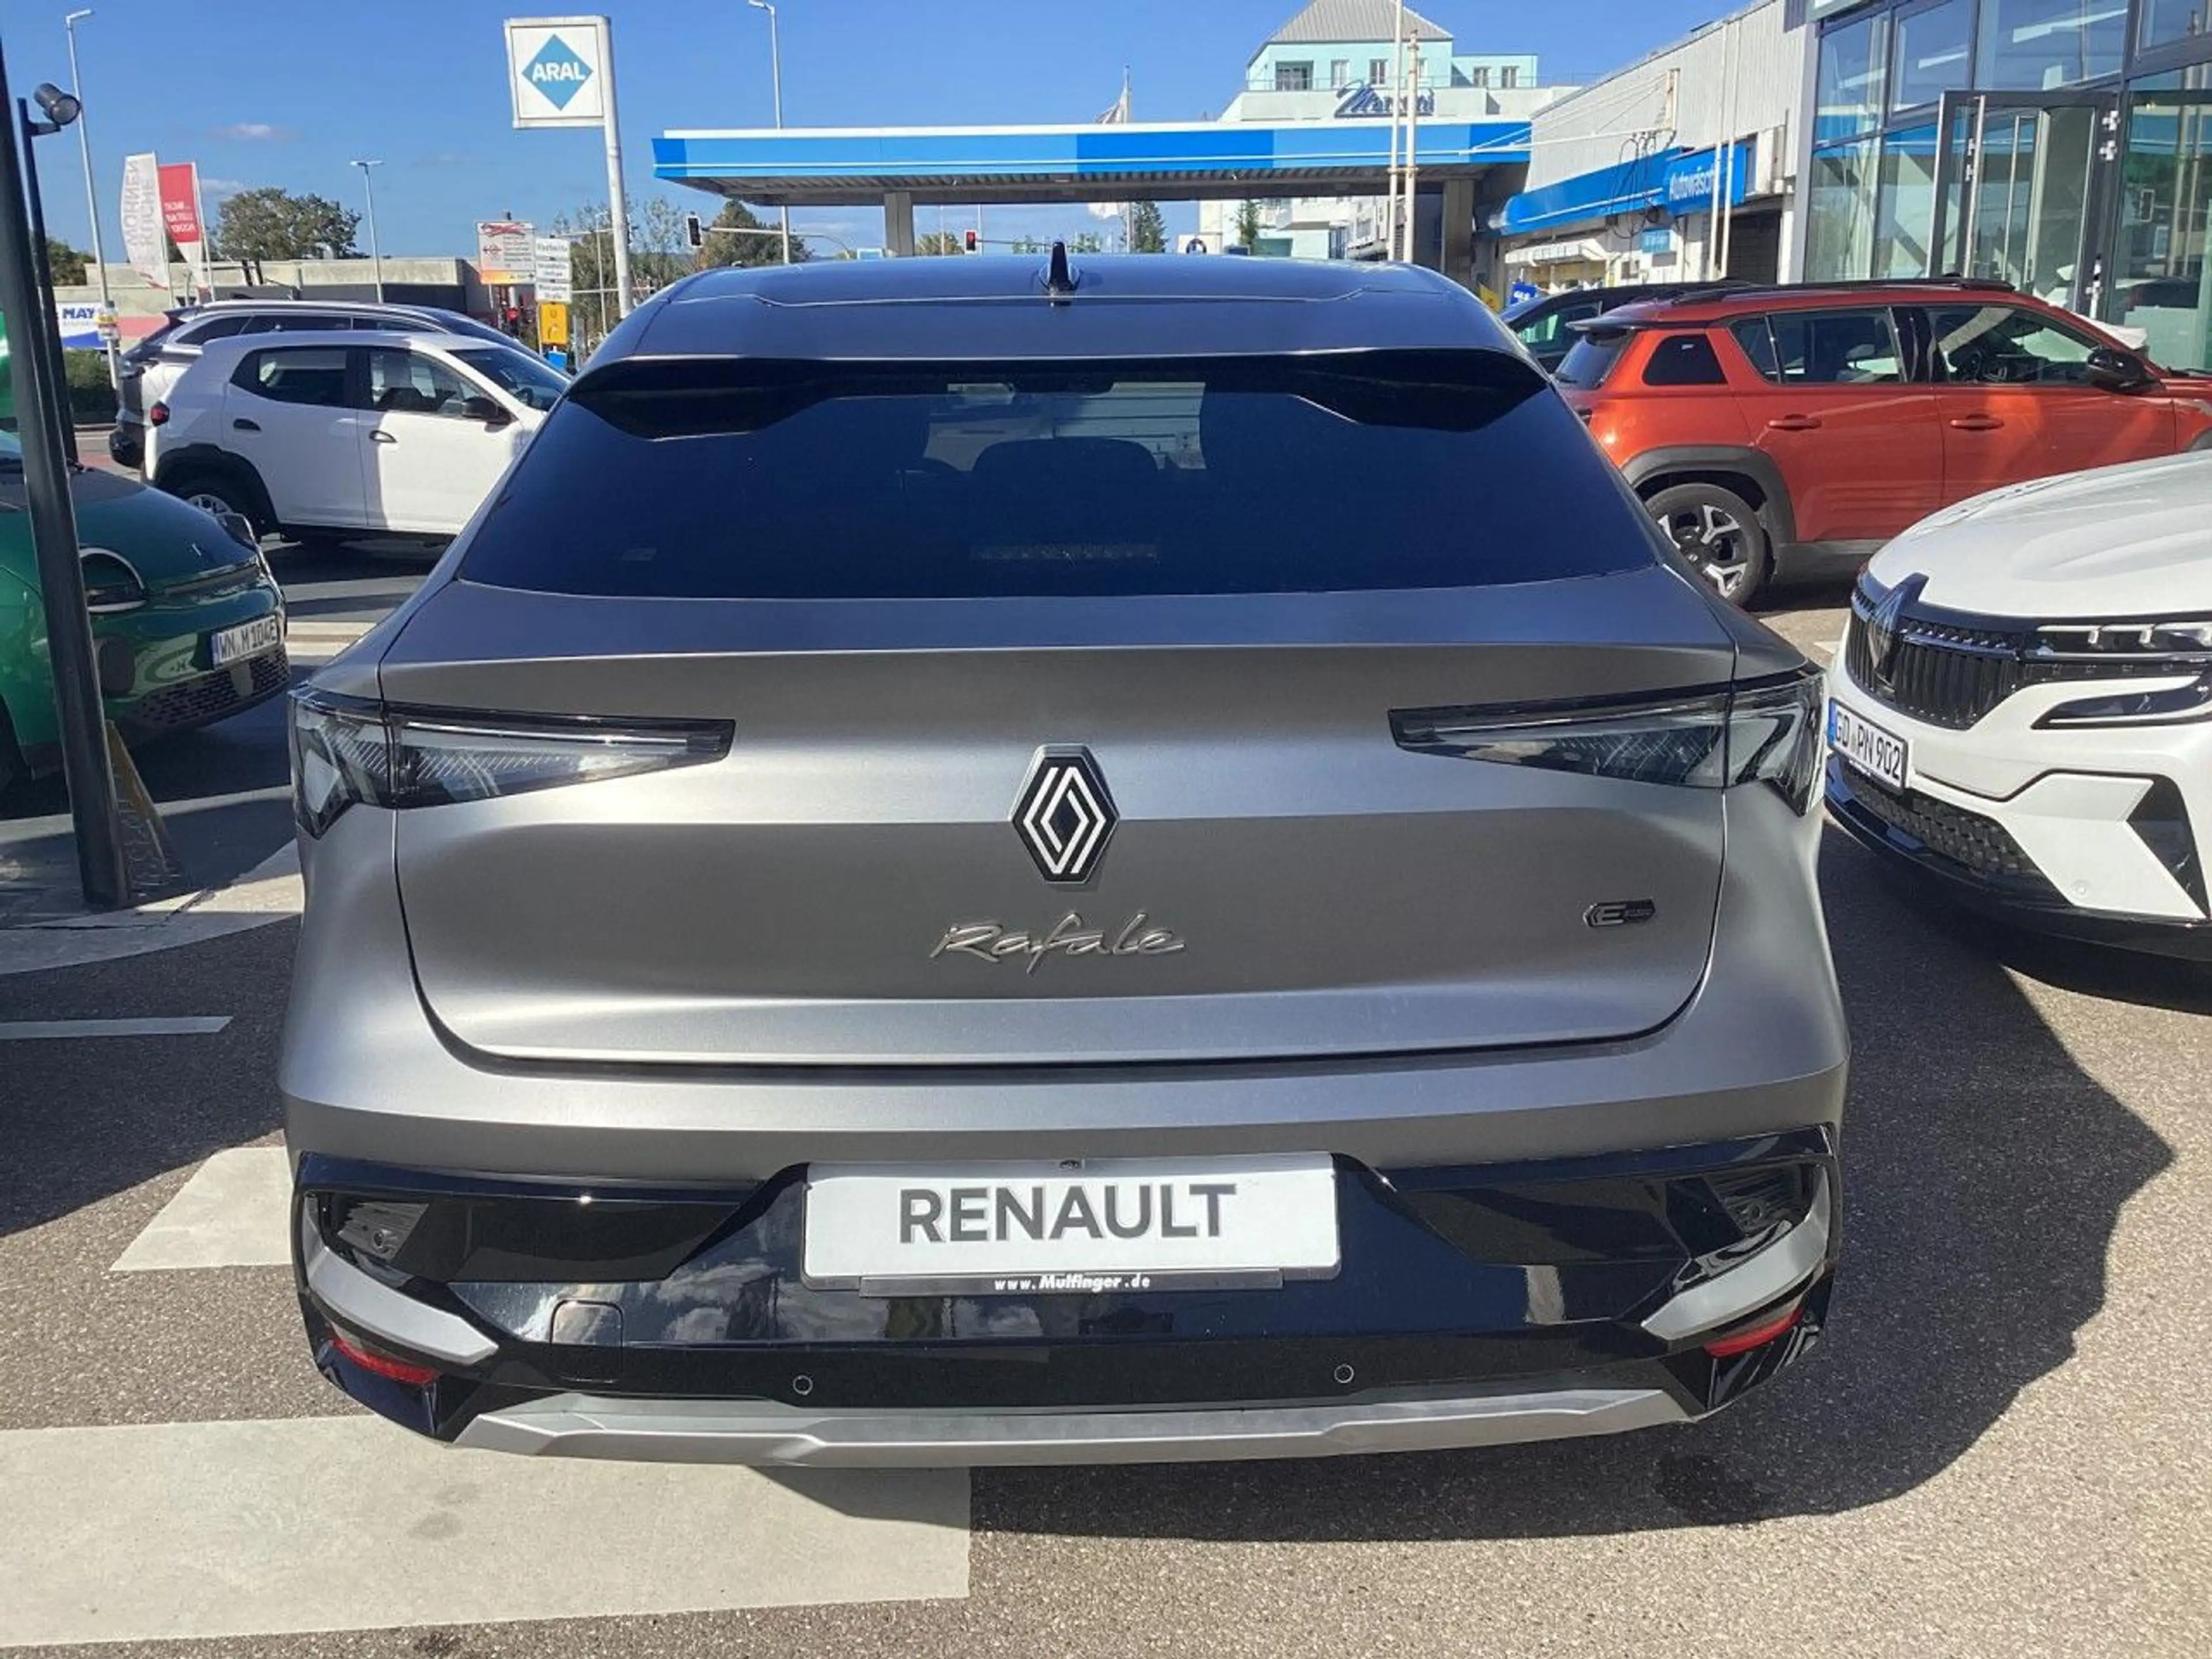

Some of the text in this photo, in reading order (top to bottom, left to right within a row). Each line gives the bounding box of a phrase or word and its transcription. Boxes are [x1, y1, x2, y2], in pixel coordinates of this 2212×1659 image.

[532, 62, 586, 82] ARAL
[1858, 724, 1874, 764] PN
[1877, 737, 1900, 780] 902
[929, 911, 1188, 975] Rafale
[899, 1183, 1237, 1243] RENAULT
